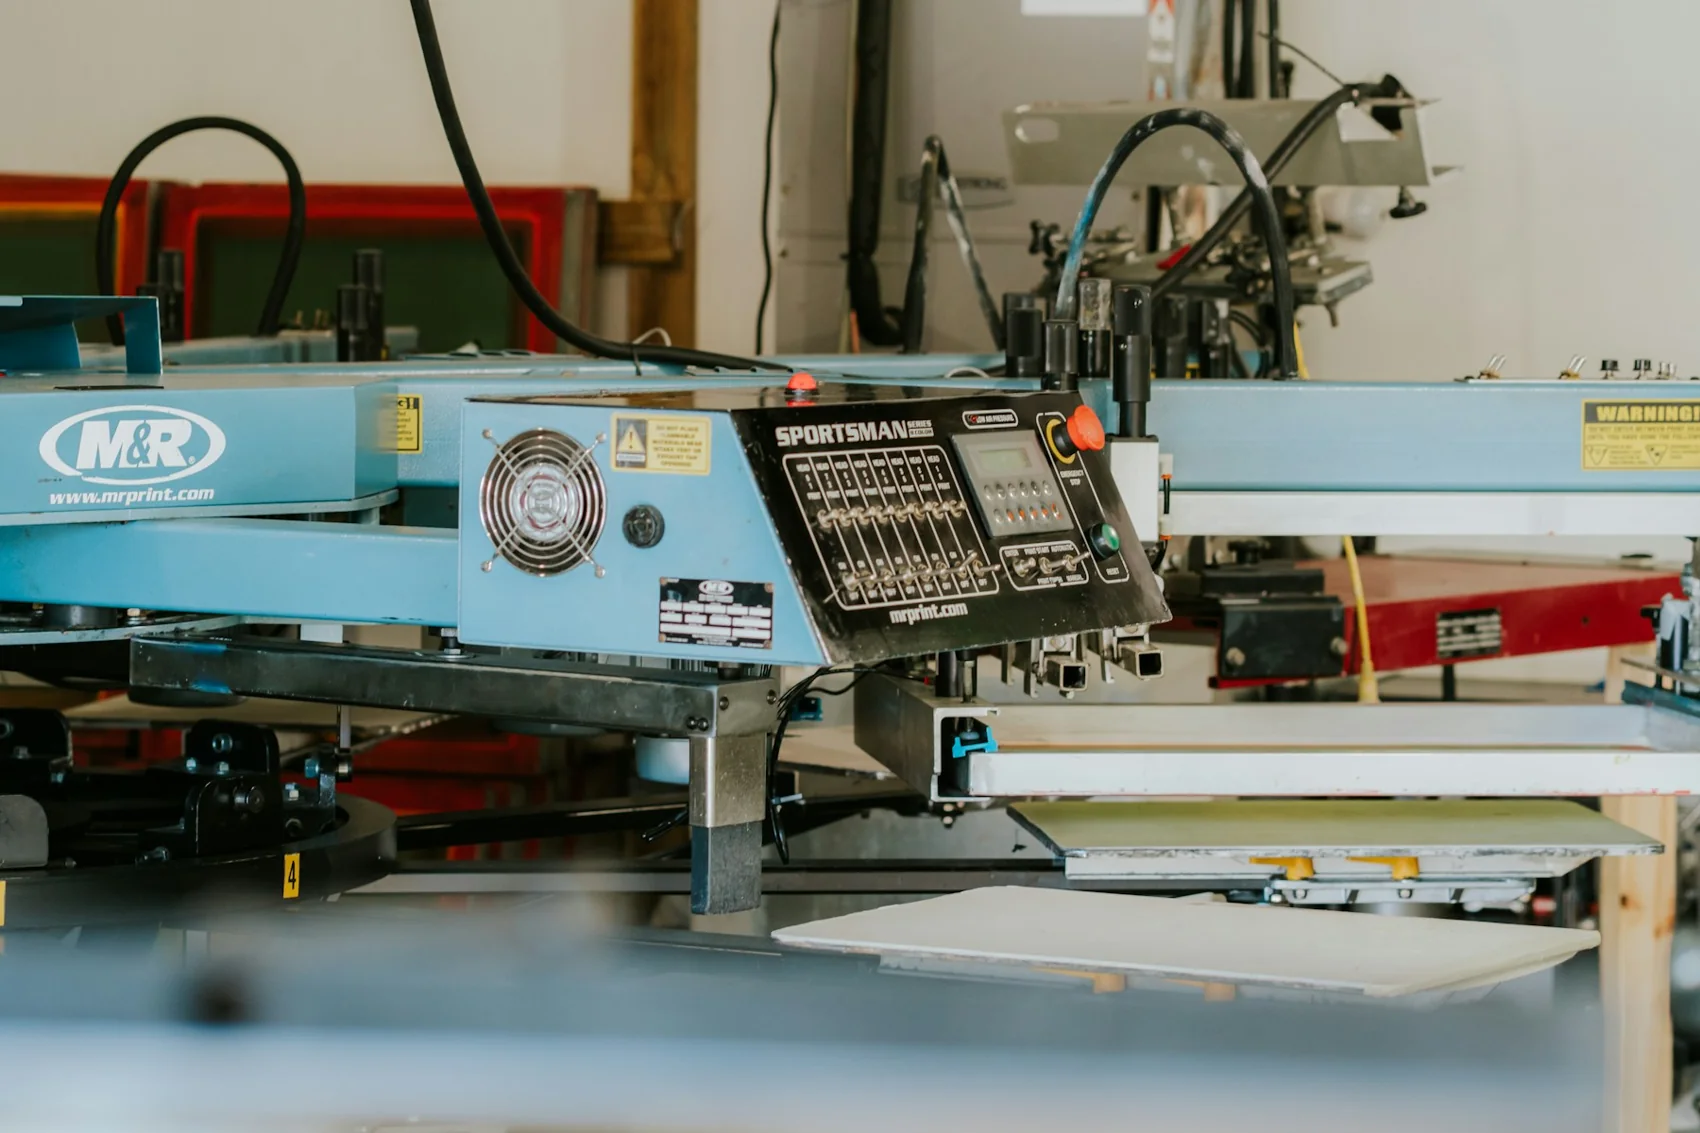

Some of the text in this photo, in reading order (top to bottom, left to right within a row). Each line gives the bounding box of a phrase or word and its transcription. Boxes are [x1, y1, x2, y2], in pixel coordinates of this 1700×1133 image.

[76, 419, 192, 469] M&R
[775, 420, 932, 447] SPORTSMAN SERIES
[50, 487, 215, 506] www.mrprint.com
[889, 603, 969, 626] mrprint.com
[288, 860, 297, 890] 4
